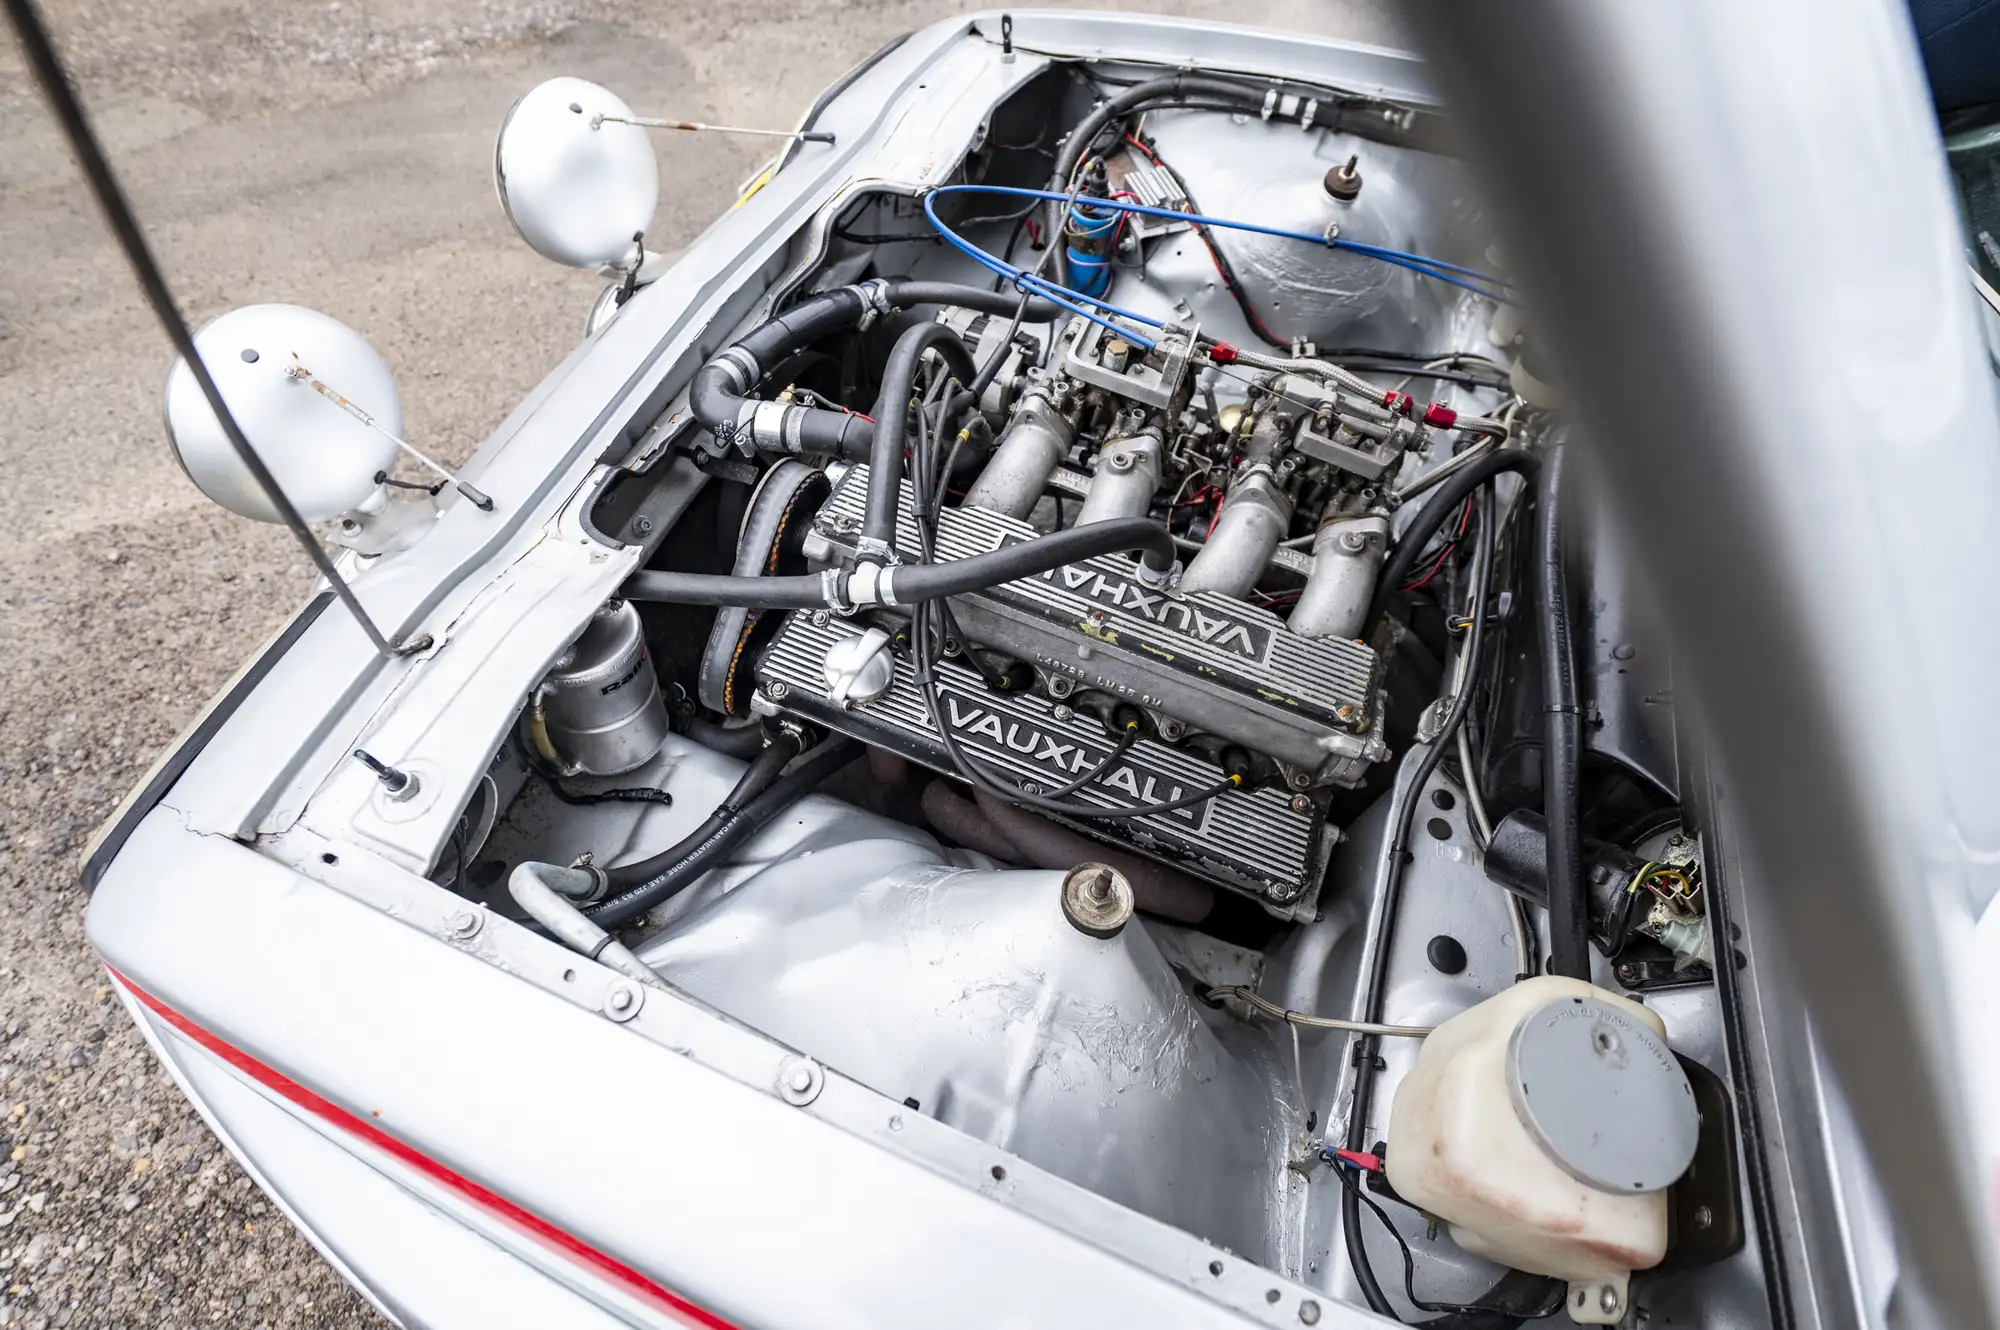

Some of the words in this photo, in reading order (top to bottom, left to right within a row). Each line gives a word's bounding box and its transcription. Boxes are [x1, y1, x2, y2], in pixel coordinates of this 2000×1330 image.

[1011, 541, 1255, 656] VAUXHA
[948, 697, 1194, 820] VAUXHALL
[714, 825, 729, 841] CAR
[689, 837, 716, 862] HEATER
[665, 858, 690, 877] HOSE
[648, 874, 666, 888] SAE
[1579, 1007, 1593, 1019] TO
